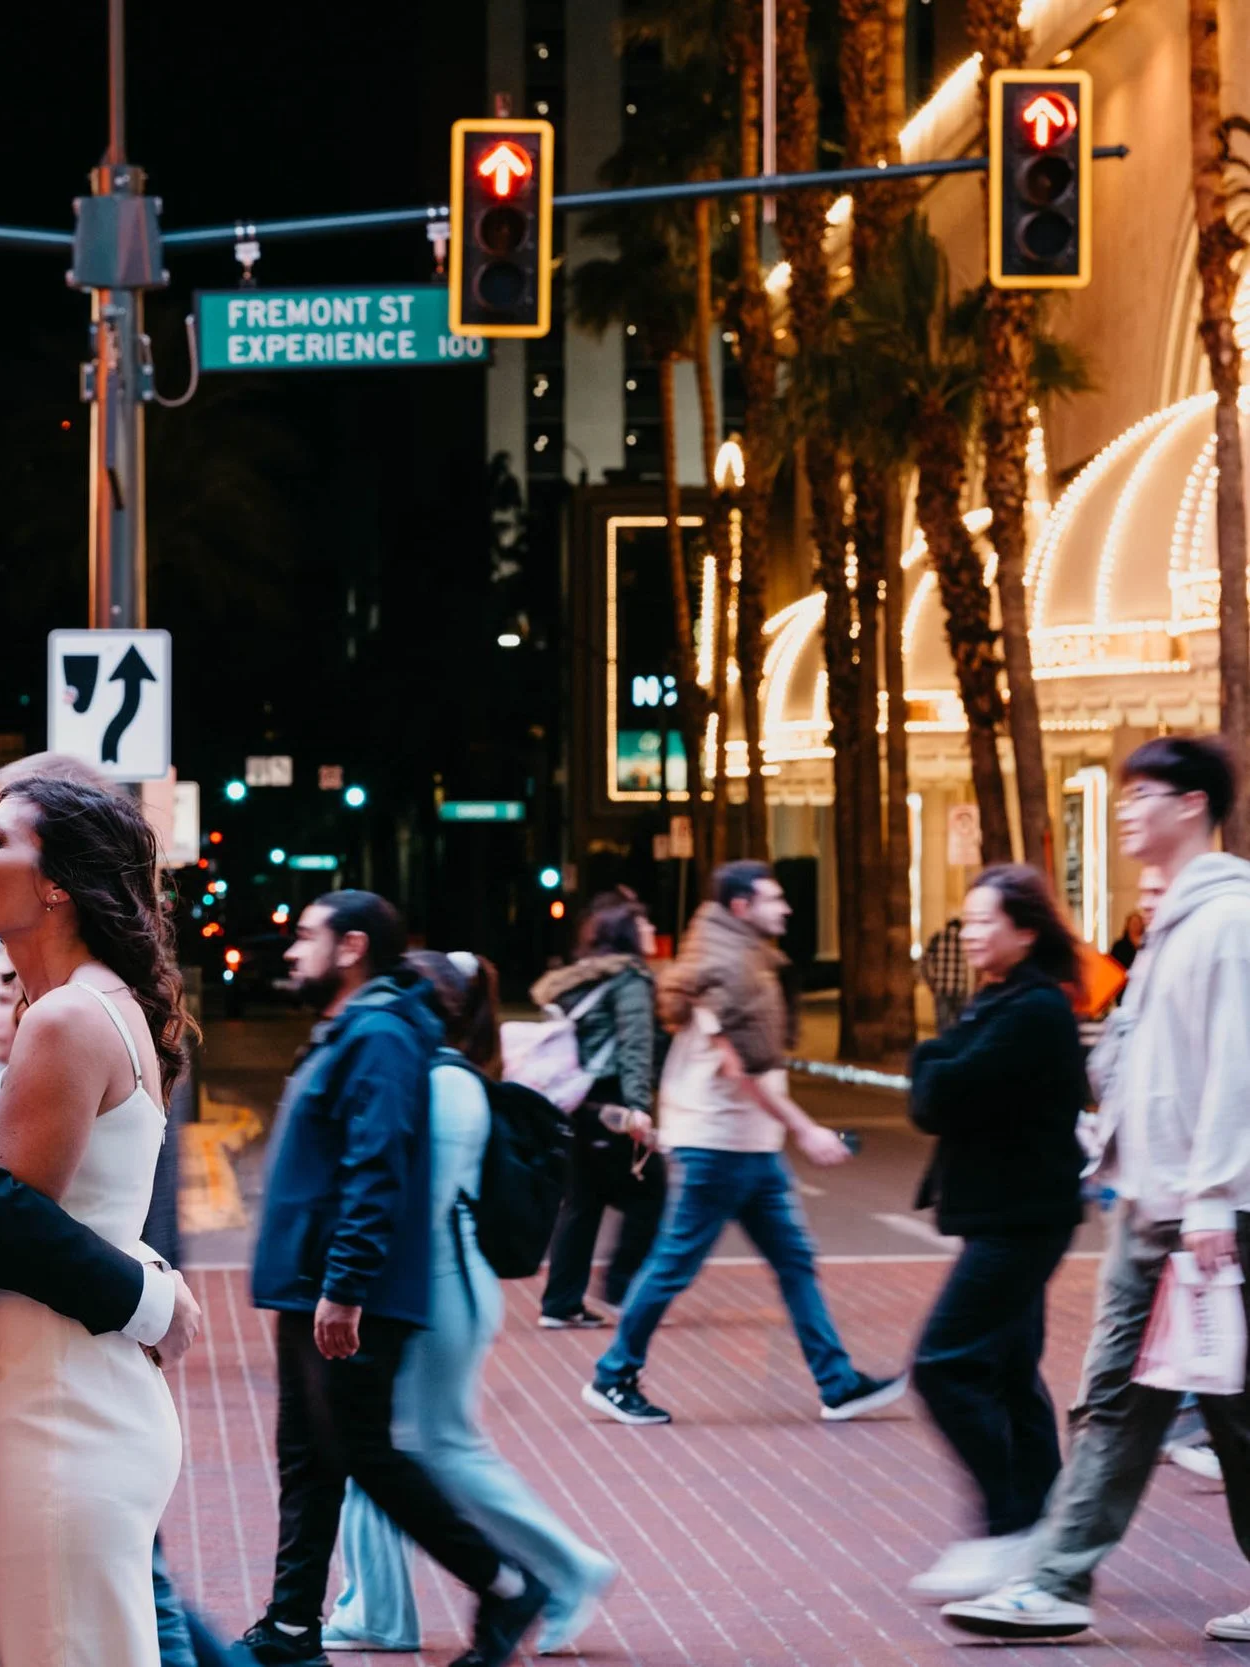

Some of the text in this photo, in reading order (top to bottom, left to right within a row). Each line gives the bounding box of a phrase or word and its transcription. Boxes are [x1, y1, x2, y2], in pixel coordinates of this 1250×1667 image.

[227, 295, 415, 328] FREMONT ST
[227, 330, 484, 364] EXPERIENCE 100
